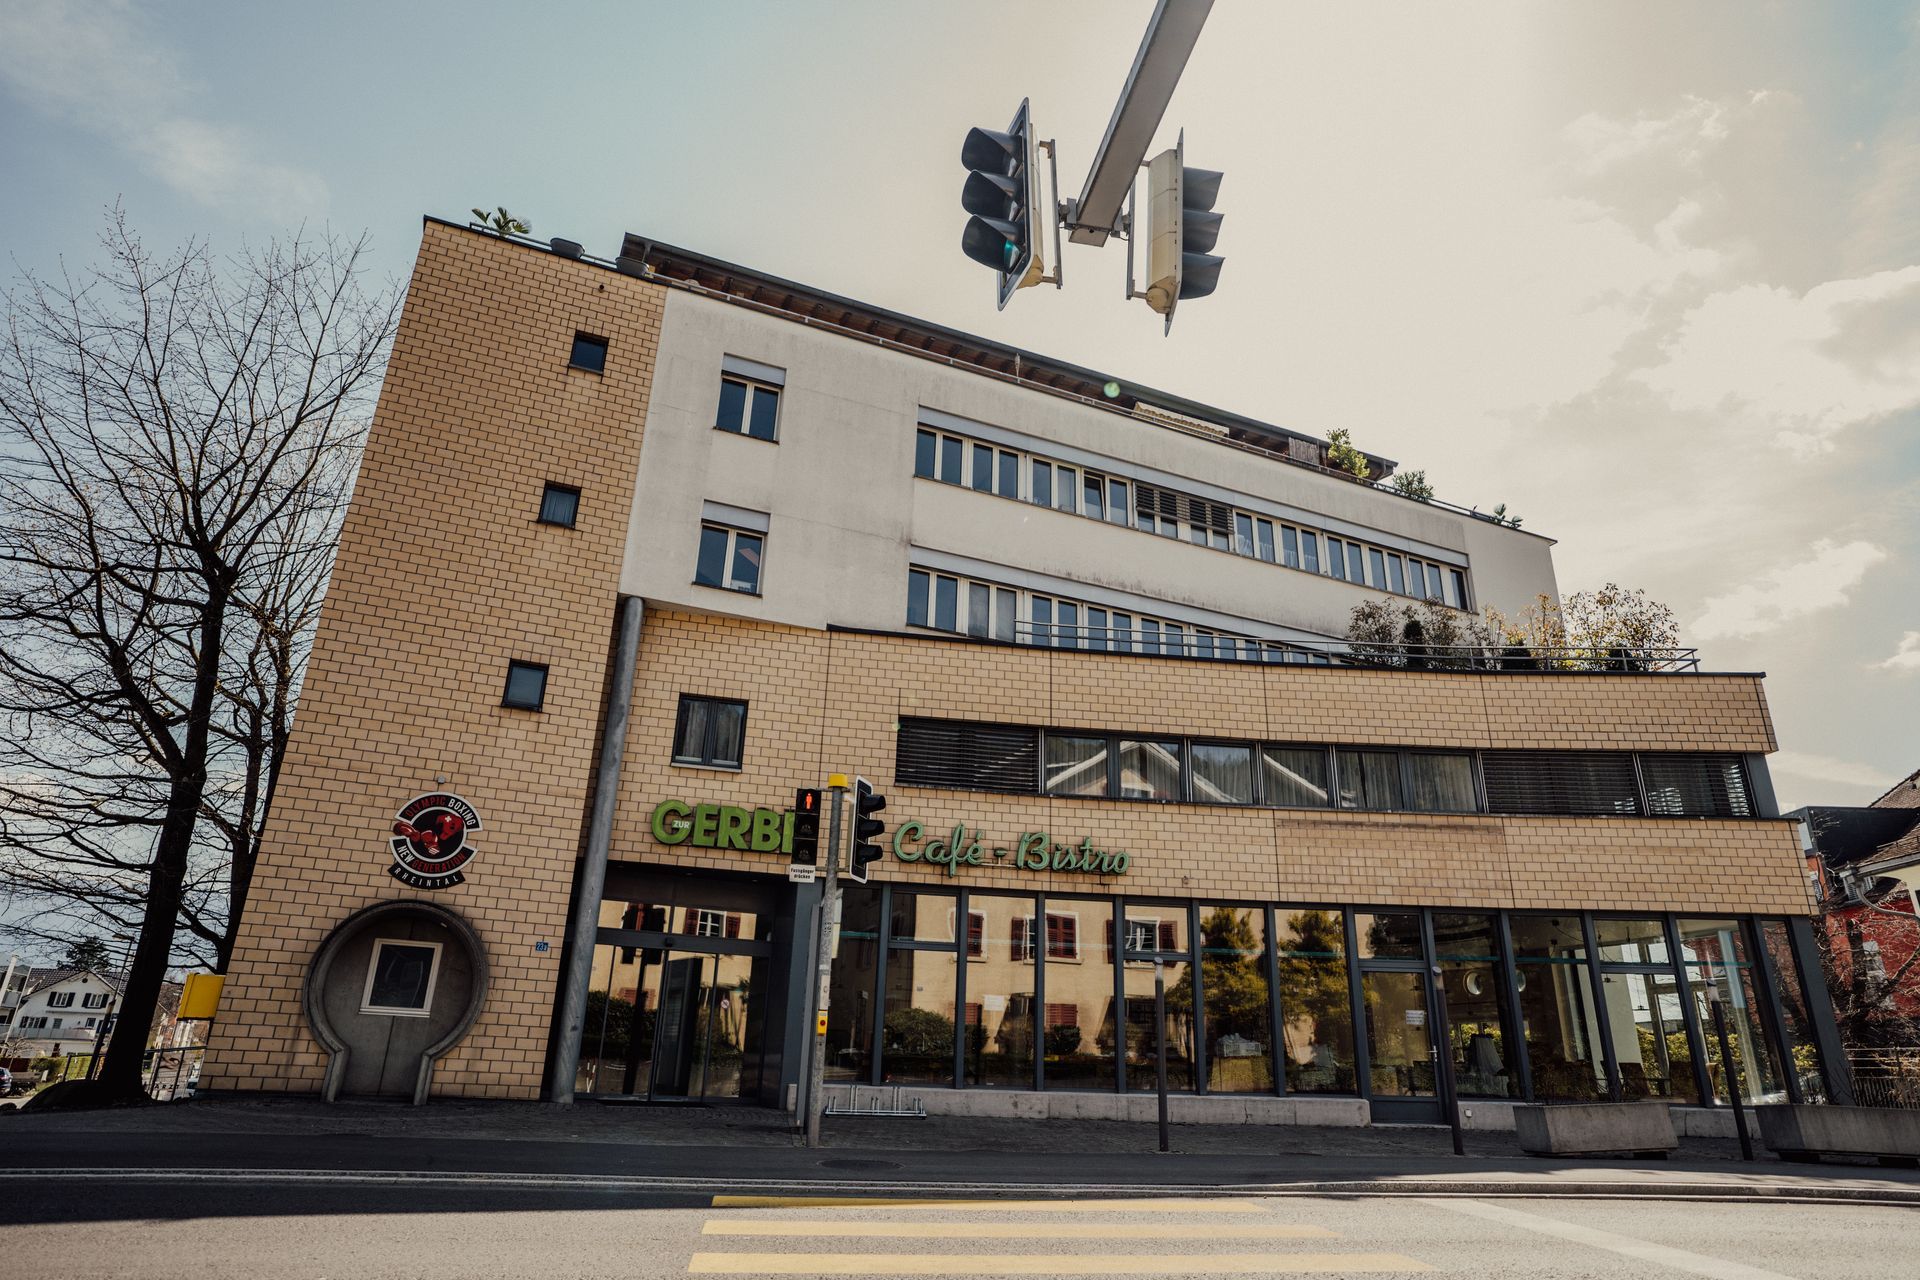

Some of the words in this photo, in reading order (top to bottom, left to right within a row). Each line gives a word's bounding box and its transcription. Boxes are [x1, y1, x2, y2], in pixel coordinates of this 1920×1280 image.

[405, 796, 447, 817] OLYMPIC
[448, 798, 476, 826] BOXING
[672, 819, 690, 829] ZUR
[397, 845, 415, 864] NEW
[412, 853, 466, 873] GENERATION
[893, 820, 984, 878] Café
[1017, 831, 1130, 874] Bistro
[393, 867, 459, 887] RHEINTAL
